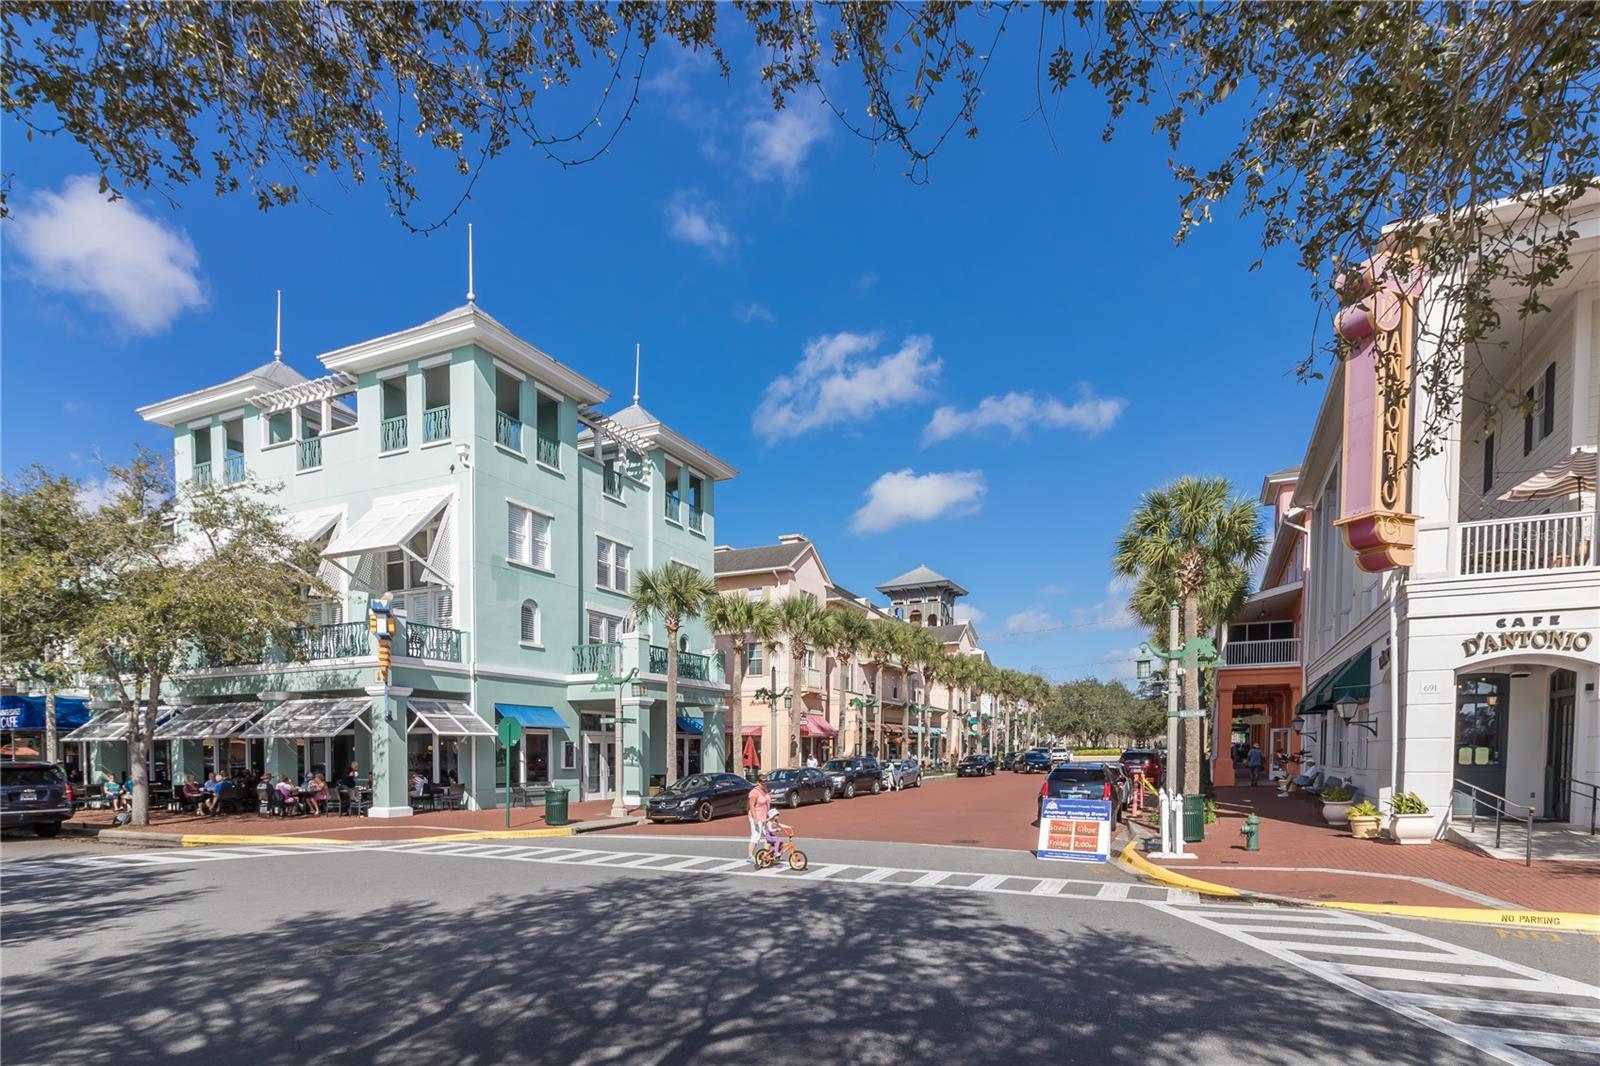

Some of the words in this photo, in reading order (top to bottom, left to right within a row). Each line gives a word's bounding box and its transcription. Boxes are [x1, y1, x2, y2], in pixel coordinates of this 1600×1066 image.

[1377, 296, 1402, 503] D'ANONIO
[1496, 615, 1561, 628] CAFE
[1461, 629, 1593, 658] D'ANTONIO
[1423, 684, 1437, 692] 691
[1, 716, 18, 728] CAFE
[1501, 914, 1515, 923] NO
[1519, 915, 1561, 925] PARKING
